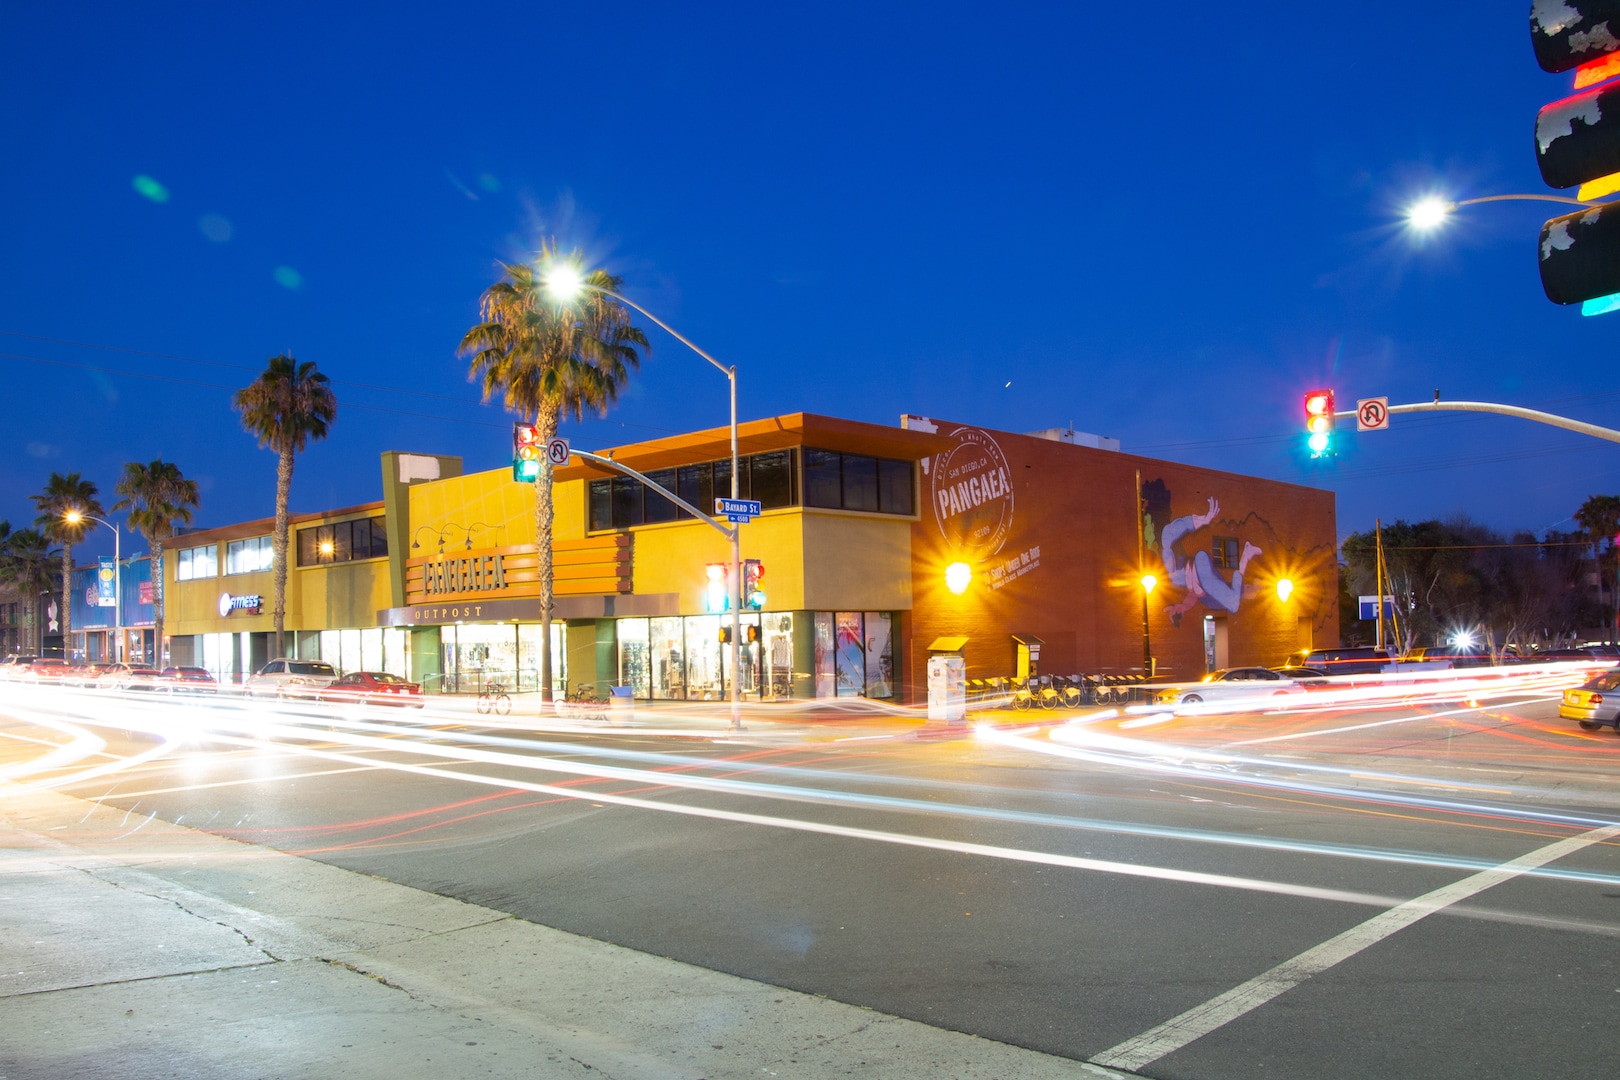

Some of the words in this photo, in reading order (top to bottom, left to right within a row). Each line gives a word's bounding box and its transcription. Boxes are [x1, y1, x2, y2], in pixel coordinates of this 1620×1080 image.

[949, 468, 960, 479] SAN
[938, 467, 1010, 519] PANGAEA
[725, 502, 748, 513] BAYARD
[990, 564, 1006, 581] SHOPS
[1006, 556, 1021, 573] UNDER
[1020, 551, 1031, 565] ONE
[1029, 545, 1041, 561] ROOF
[422, 554, 506, 596] PANGAEA
[1004, 572, 1017, 584] CLASS
[230, 594, 259, 610] FITNESS
[415, 606, 482, 619] OUTPOST
